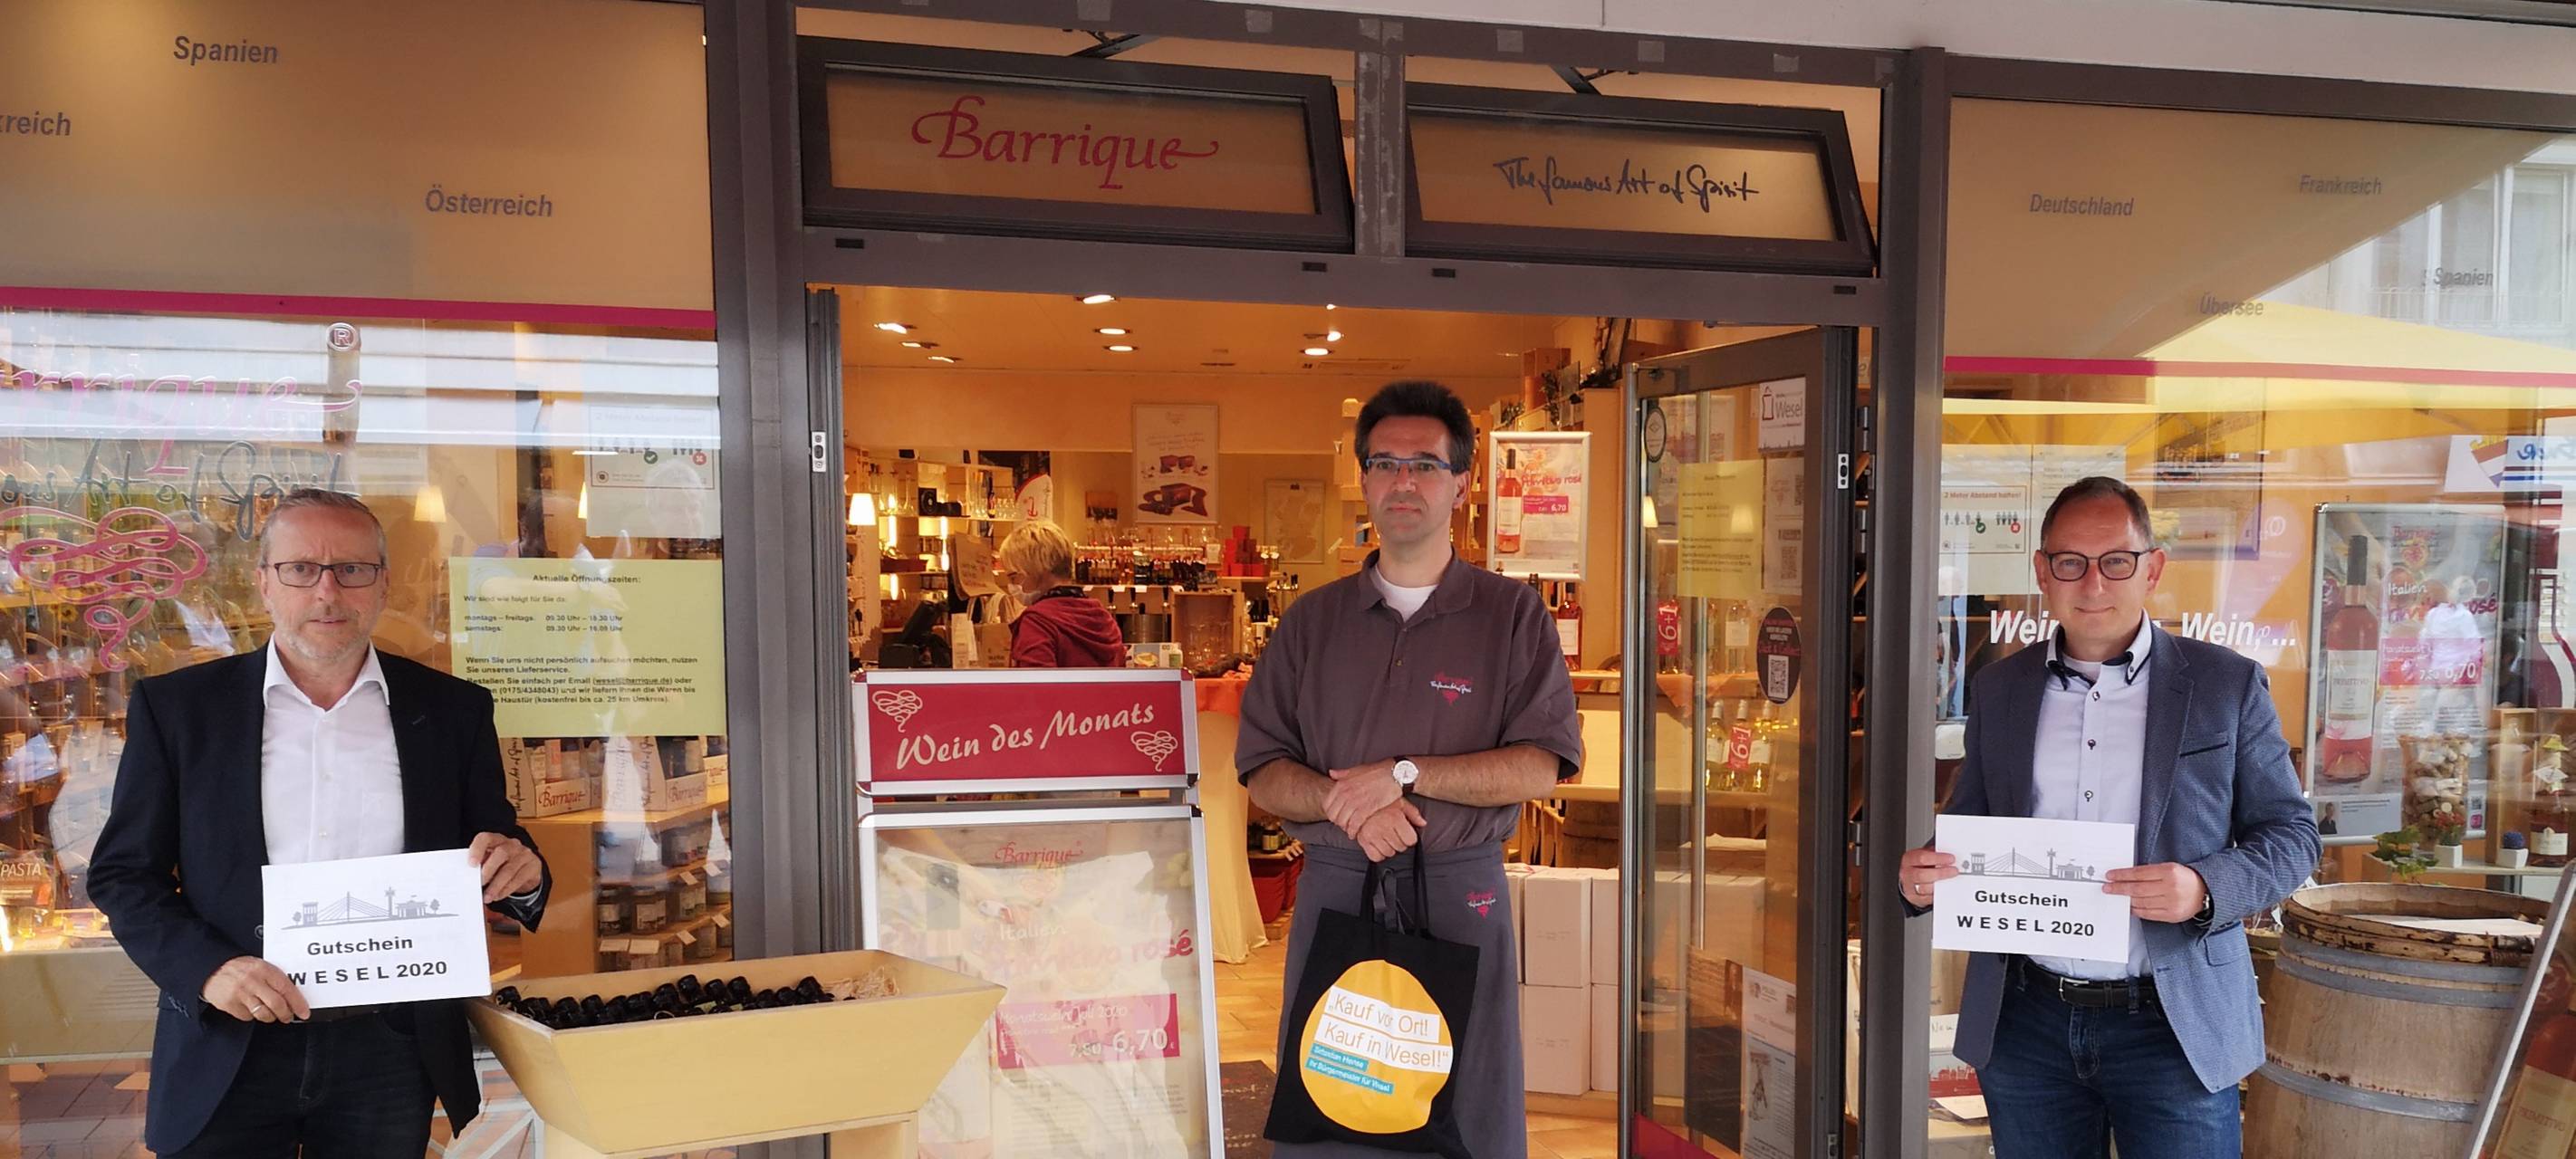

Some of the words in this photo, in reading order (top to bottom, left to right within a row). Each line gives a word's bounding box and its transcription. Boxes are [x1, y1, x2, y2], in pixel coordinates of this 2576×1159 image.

[173, 35, 279, 66] Spanien
[911, 94, 1219, 190] Barrique
[1493, 157, 1535, 189] The
[1538, 156, 1611, 206] famous
[1616, 158, 1656, 195] Art
[1658, 170, 1685, 204] of
[1687, 164, 1760, 213] Spirit
[2300, 174, 2383, 196] Frankreich
[425, 186, 553, 218] Österreich
[2029, 193, 2134, 217] Deutschland
[2199, 292, 2265, 317] Übersee
[1775, 397, 1803, 419] Wesel
[0, 369, 363, 475] rrique
[217, 439, 362, 542] Spt
[533, 574, 569, 582] Aktuelle
[491, 656, 505, 665] Sie
[546, 656, 589, 666] persönlich
[516, 666, 570, 674] Lieferservice.
[553, 678, 566, 686] per
[534, 695, 578, 704] (kostenfrei
[896, 733, 980, 771] Wein
[989, 723, 1033, 752] des
[1039, 703, 1155, 751] Monats
[995, 840, 1084, 870] Barrique
[0, 862, 42, 877] PASTA
[1975, 890, 2069, 908] Gutschein
[2051, 921, 2095, 937] 2020
[307, 935, 414, 956] Gutschein
[396, 961, 448, 978] 2020
[1399, 1015, 1428, 1037] Ort!
[1112, 1028, 1168, 1057] 6,70
[1324, 1021, 1365, 1049] Kauf
[1367, 1035, 1381, 1057] in
